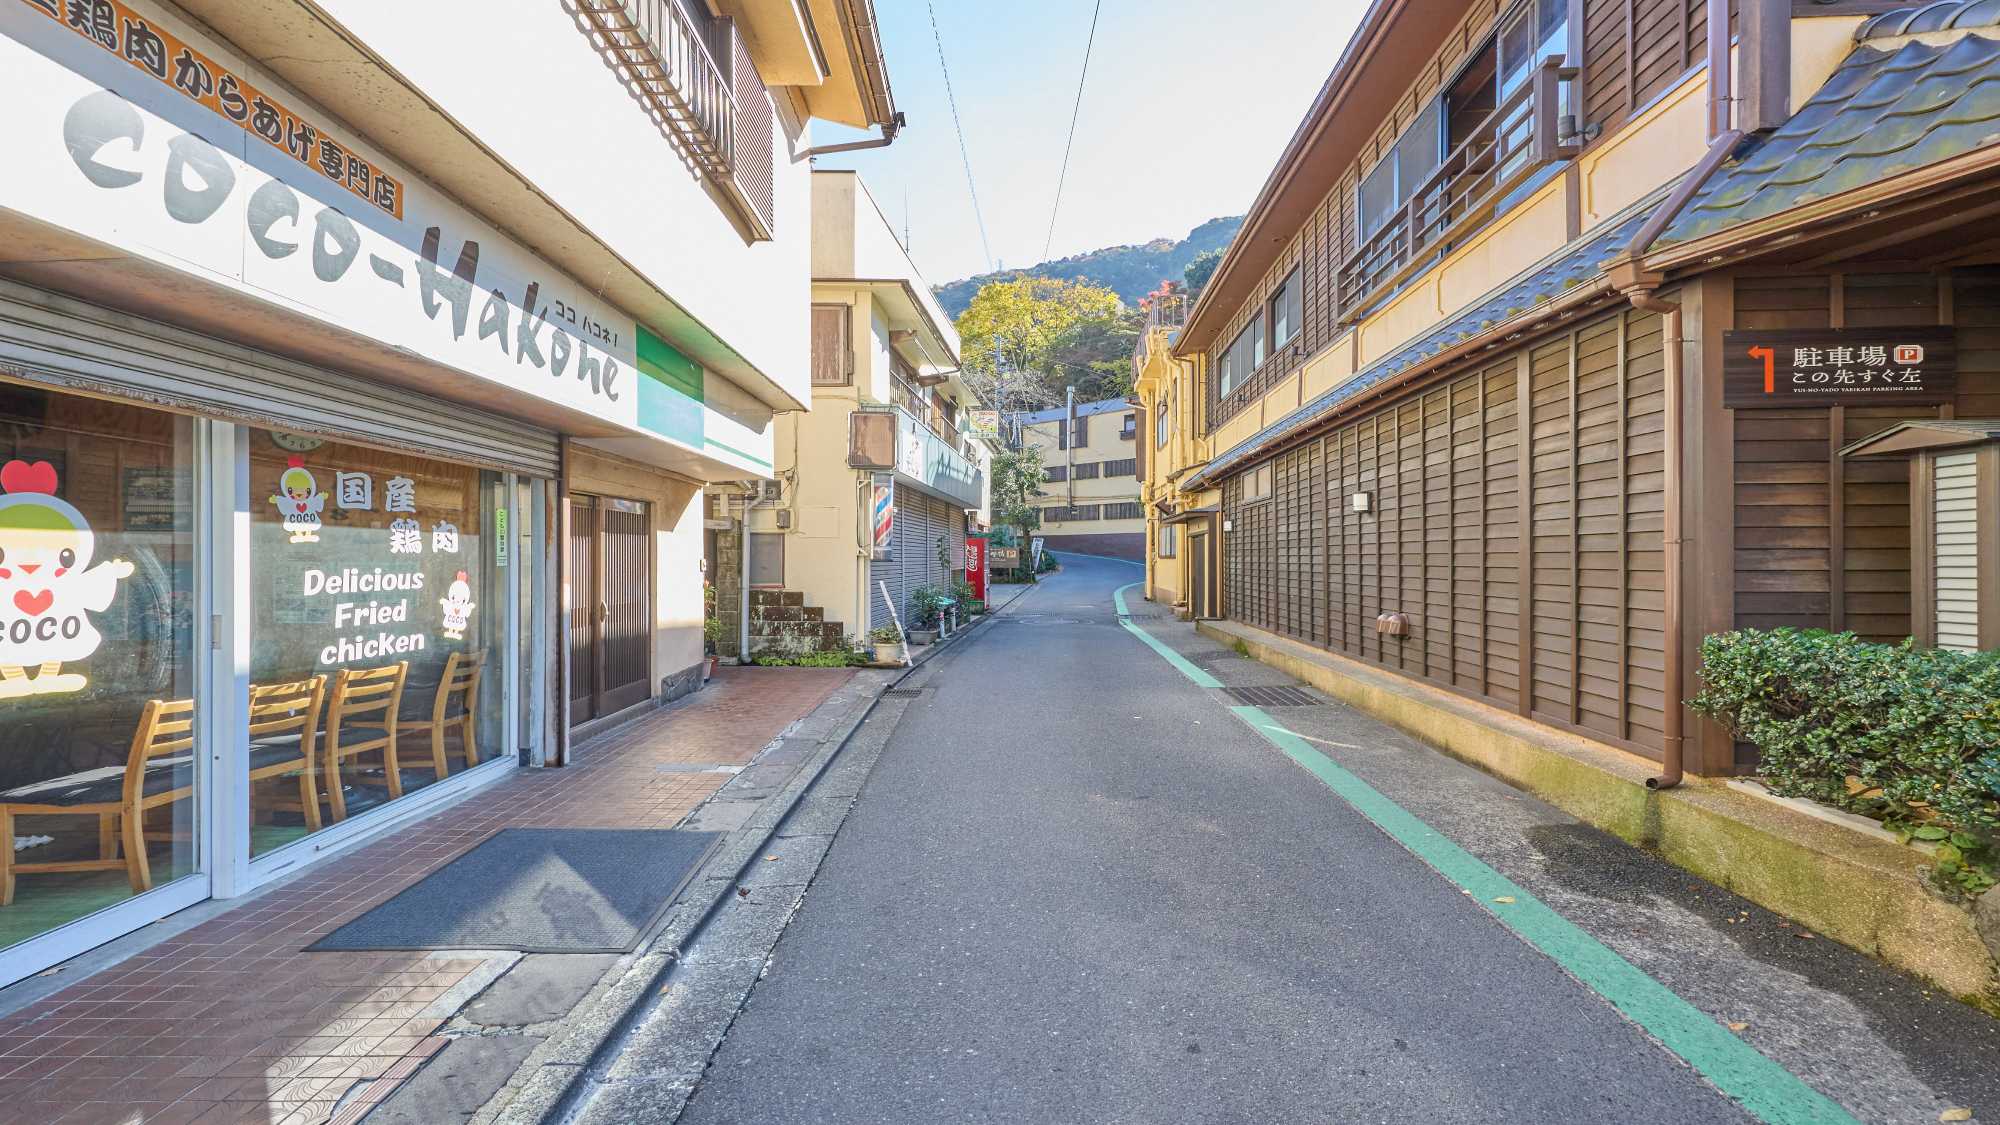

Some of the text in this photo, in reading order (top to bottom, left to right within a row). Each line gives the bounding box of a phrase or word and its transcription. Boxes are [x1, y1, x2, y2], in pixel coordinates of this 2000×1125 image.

[555, 299, 576, 324] ココ
[1793, 345, 1887, 367] 駐車場
[1793, 367, 1921, 384] この先すぐ左
[335, 471, 417, 513] 国産
[389, 518, 459, 554] 鶏肉
[304, 568, 425, 596] Delicious
[335, 598, 407, 628] Fried
[320, 632, 425, 665] chicken
